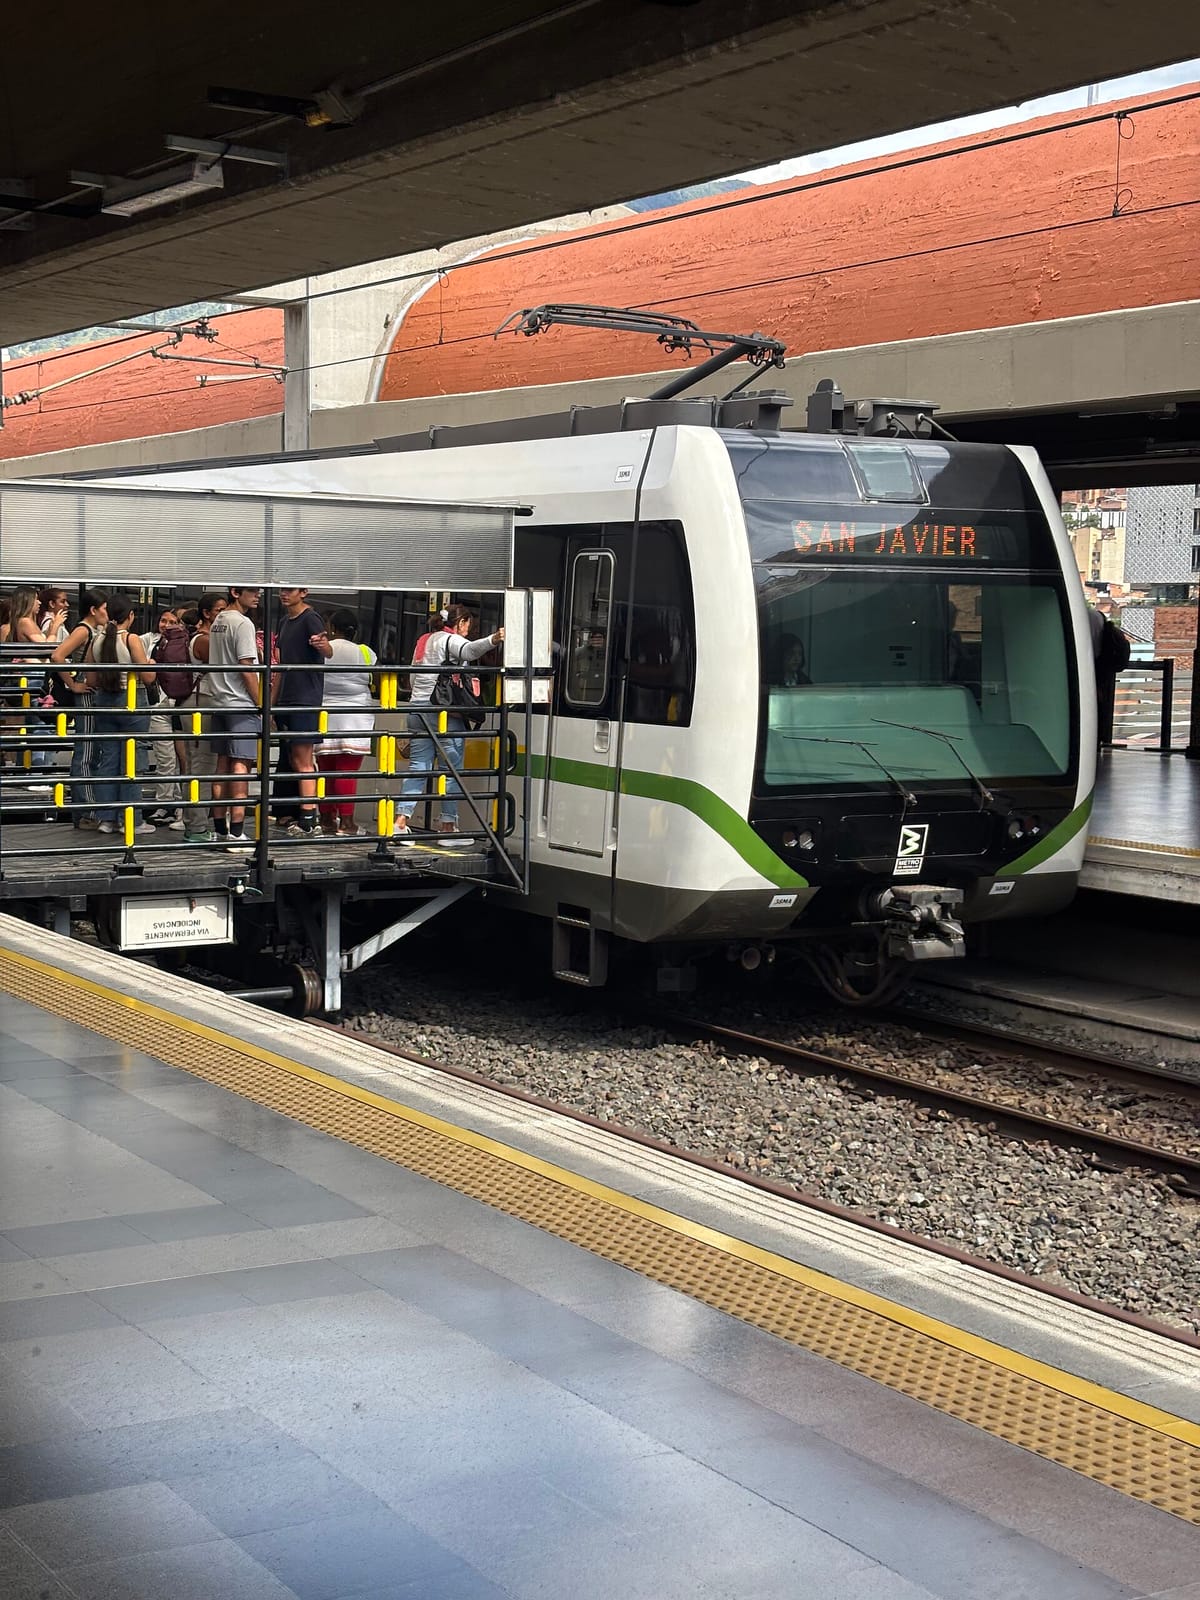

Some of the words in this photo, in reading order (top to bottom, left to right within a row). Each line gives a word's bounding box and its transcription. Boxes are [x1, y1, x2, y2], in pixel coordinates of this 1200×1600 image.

[793, 520, 855, 553] SAN
[875, 523, 976, 556] JAVIER
[153, 919, 201, 929] INCIDENCIAS
[144, 930, 195, 940] PERMANENTE
